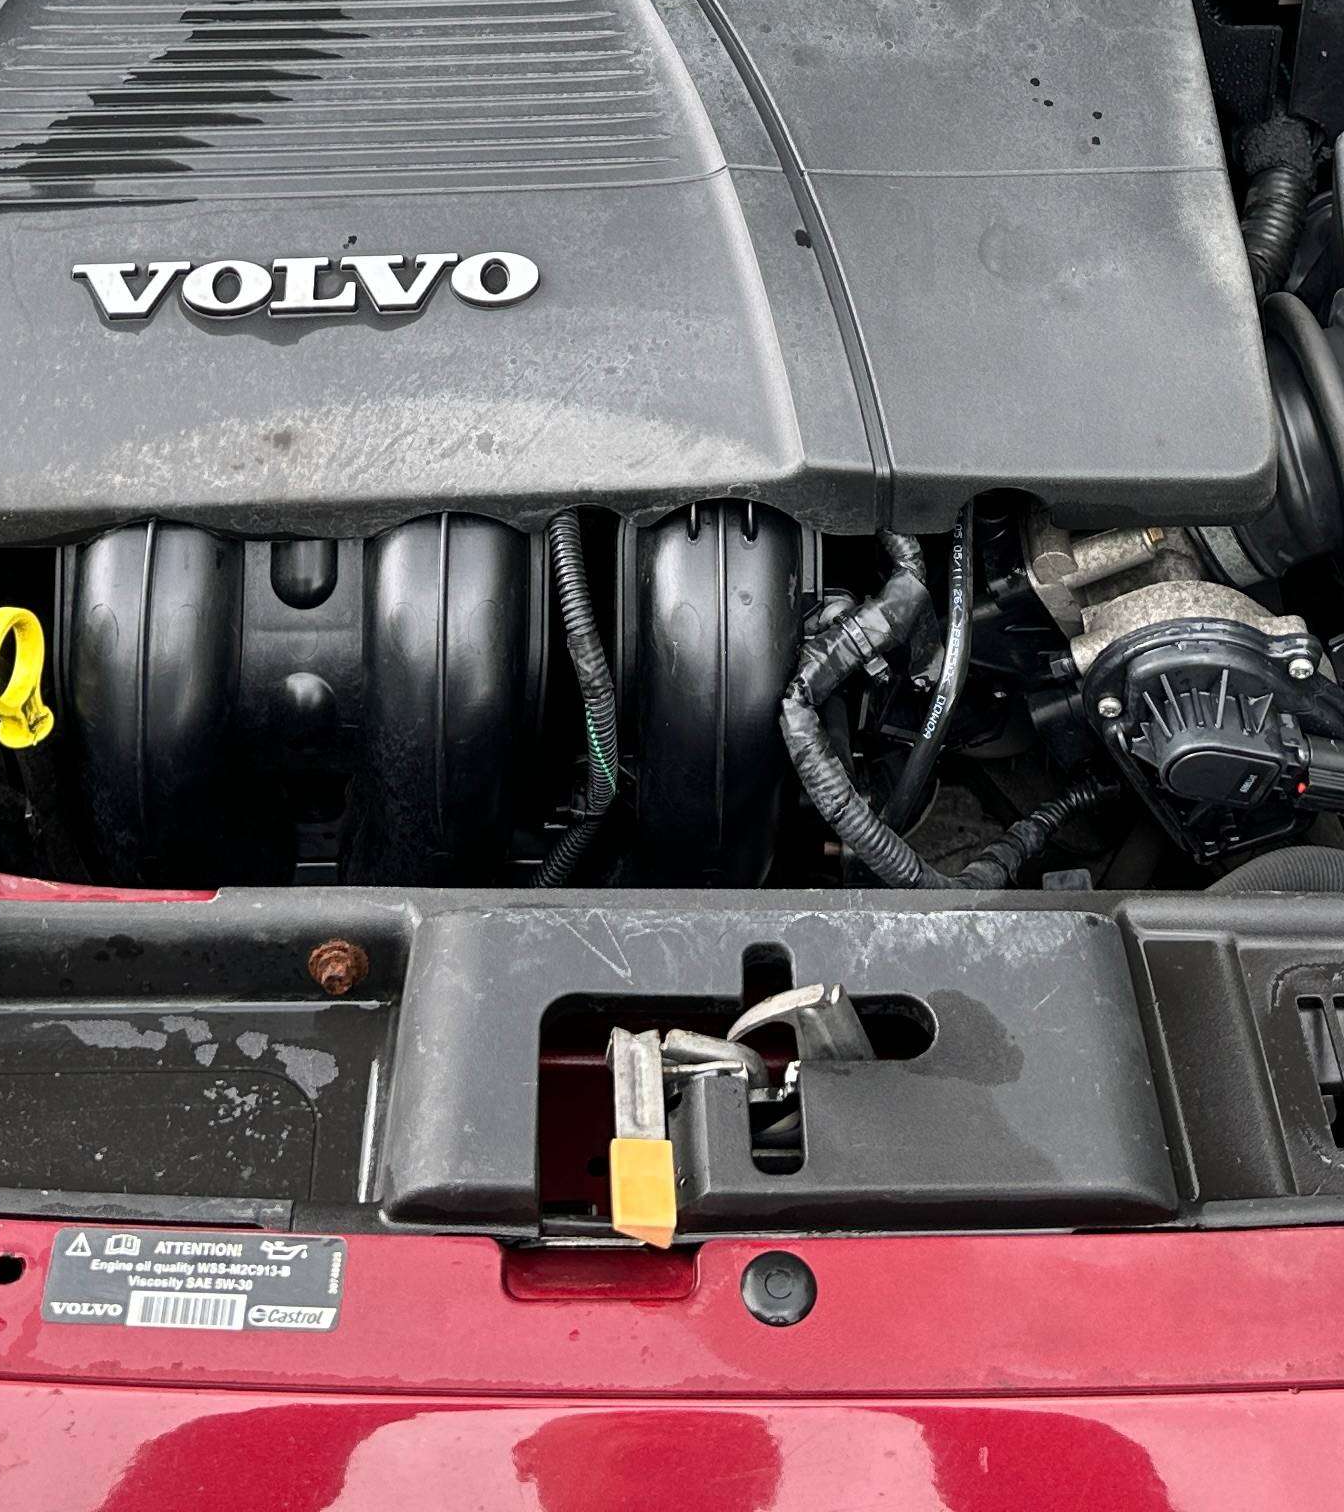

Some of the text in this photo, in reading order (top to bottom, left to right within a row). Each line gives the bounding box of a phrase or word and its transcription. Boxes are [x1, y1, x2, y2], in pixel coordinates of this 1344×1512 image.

[72, 251, 541, 320] VOLVO
[154, 1240, 243, 1257] ATTENTION!
[89, 1259, 133, 1273] Engine
[134, 1260, 152, 1272] oil
[152, 1261, 196, 1275] quality
[126, 1274, 183, 1289] Viscosity
[184, 1277, 213, 1289] SAE
[48, 1301, 323, 1325] VOLVO Castrol
